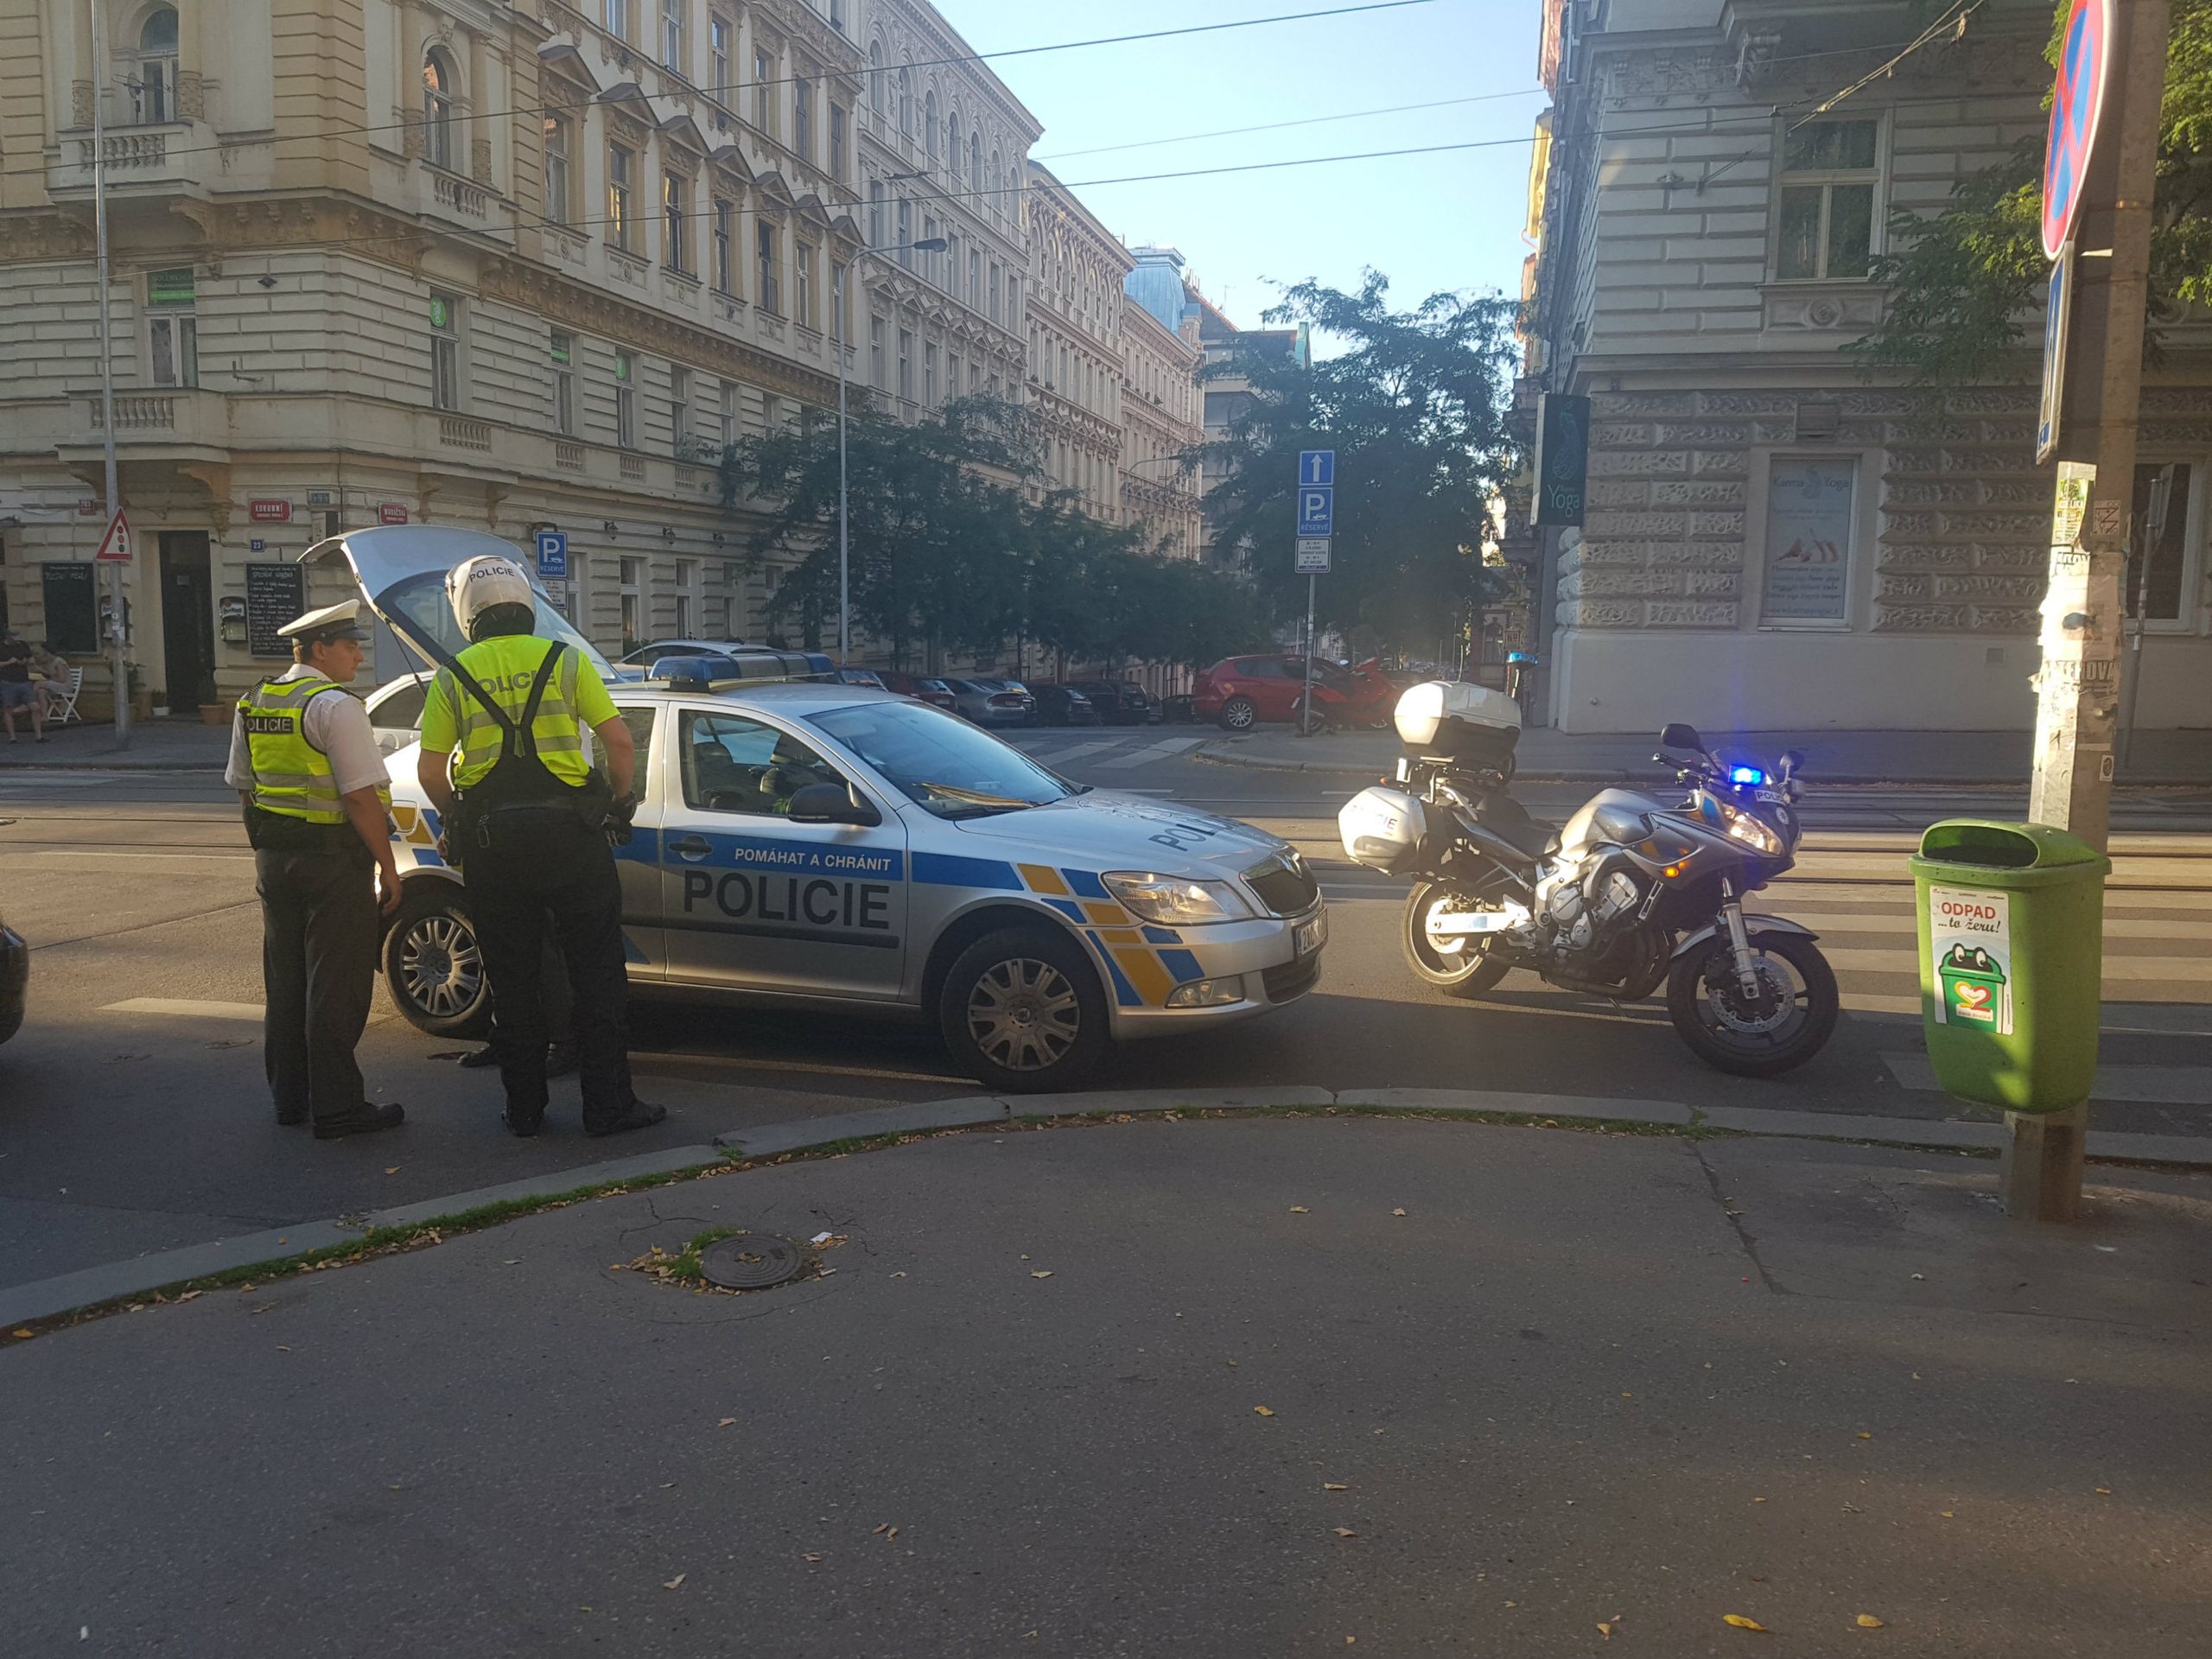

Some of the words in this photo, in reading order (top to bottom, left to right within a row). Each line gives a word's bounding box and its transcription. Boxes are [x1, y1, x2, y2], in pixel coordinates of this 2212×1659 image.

[1824, 476, 1849, 492] Yoga
[1306, 493, 1325, 521] P
[1548, 485, 1580, 518] Yoga
[253, 541, 262, 550] 23
[543, 537, 560, 563] P
[469, 566, 515, 583] POLICIE
[245, 718, 291, 732] OLICIE
[734, 847, 805, 865] POMÁHAT
[810, 854, 820, 866] A
[825, 854, 891, 872] CHRÁNIT
[683, 869, 890, 930] POLICIE
[1942, 901, 1996, 919] ODPAD
[1965, 917, 2000, 933] žeru!
